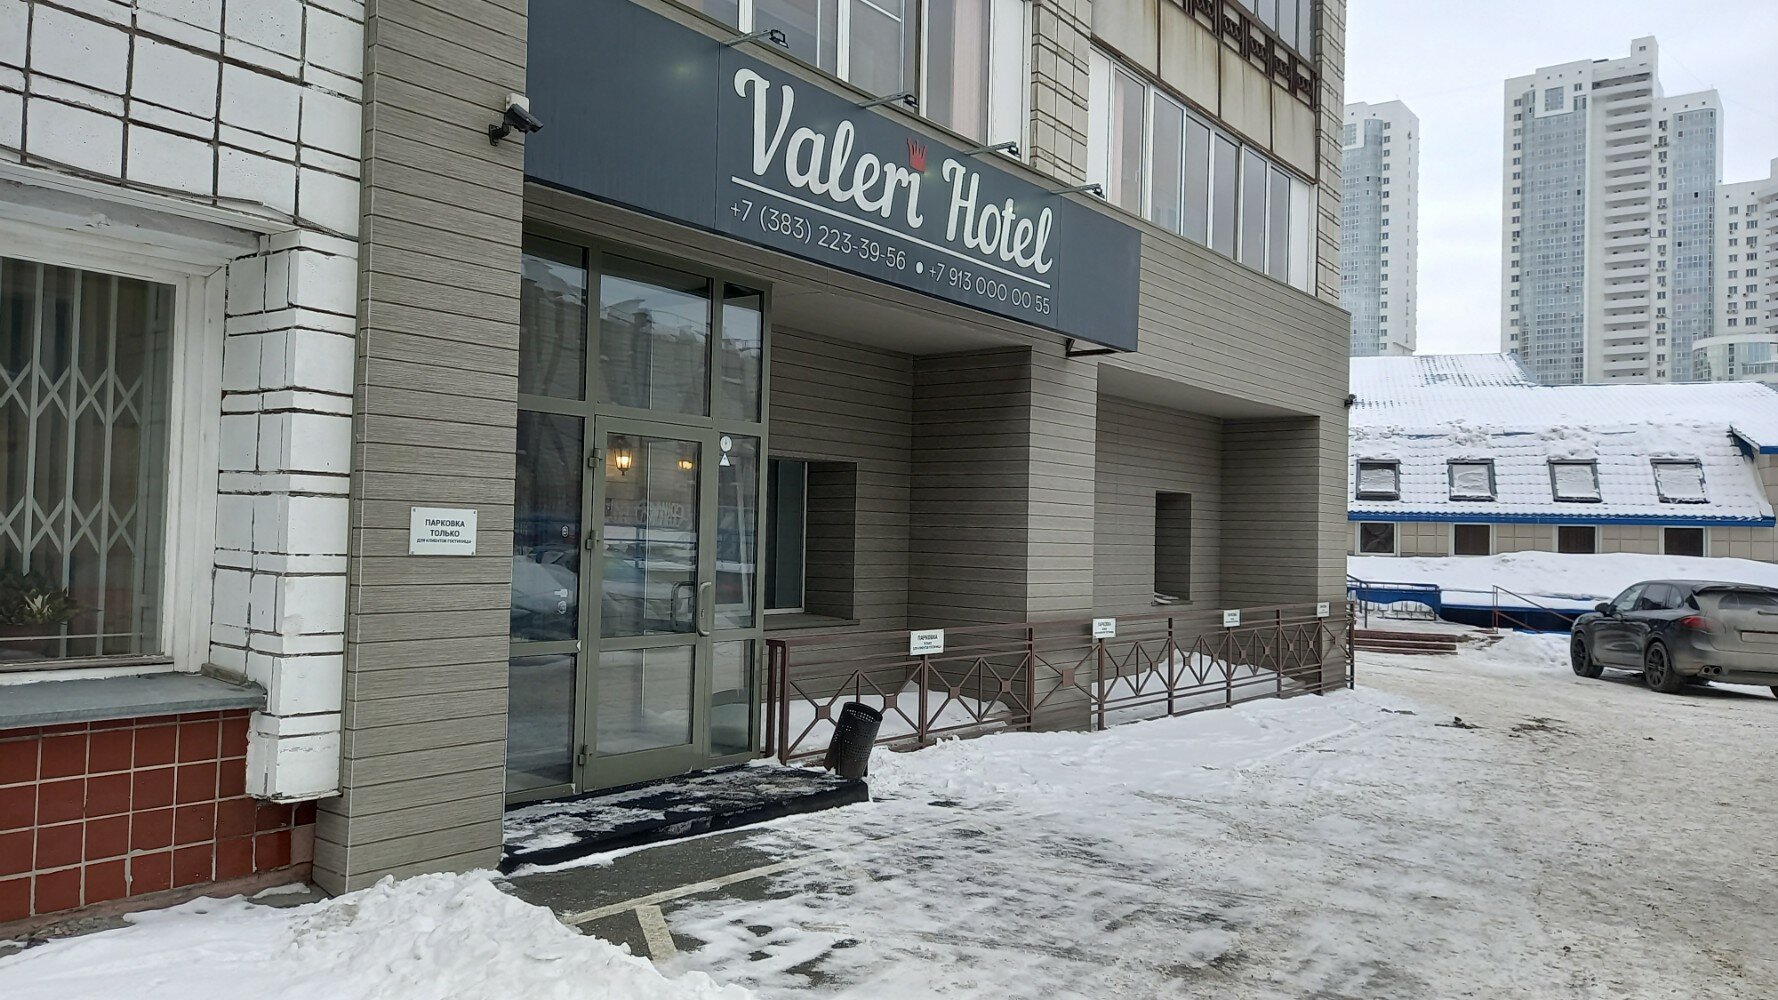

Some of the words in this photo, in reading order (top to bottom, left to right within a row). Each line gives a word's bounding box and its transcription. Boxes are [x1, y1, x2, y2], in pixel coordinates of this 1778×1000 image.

[734, 68, 925, 229] Valeri
[942, 158, 1053, 274] Hotel
[730, 199, 754, 223] +7
[759, 205, 812, 246] (383)
[817, 225, 906, 271] 223-39-56
[928, 262, 946, 282] +7
[949, 267, 973, 291] 913
[975, 276, 1008, 302] 000
[1011, 288, 1032, 309] 00
[1034, 295, 1051, 315] 55
[425, 519, 465, 527] ПАРКОВКА
[430, 529, 460, 537] ТОЛЬКО
